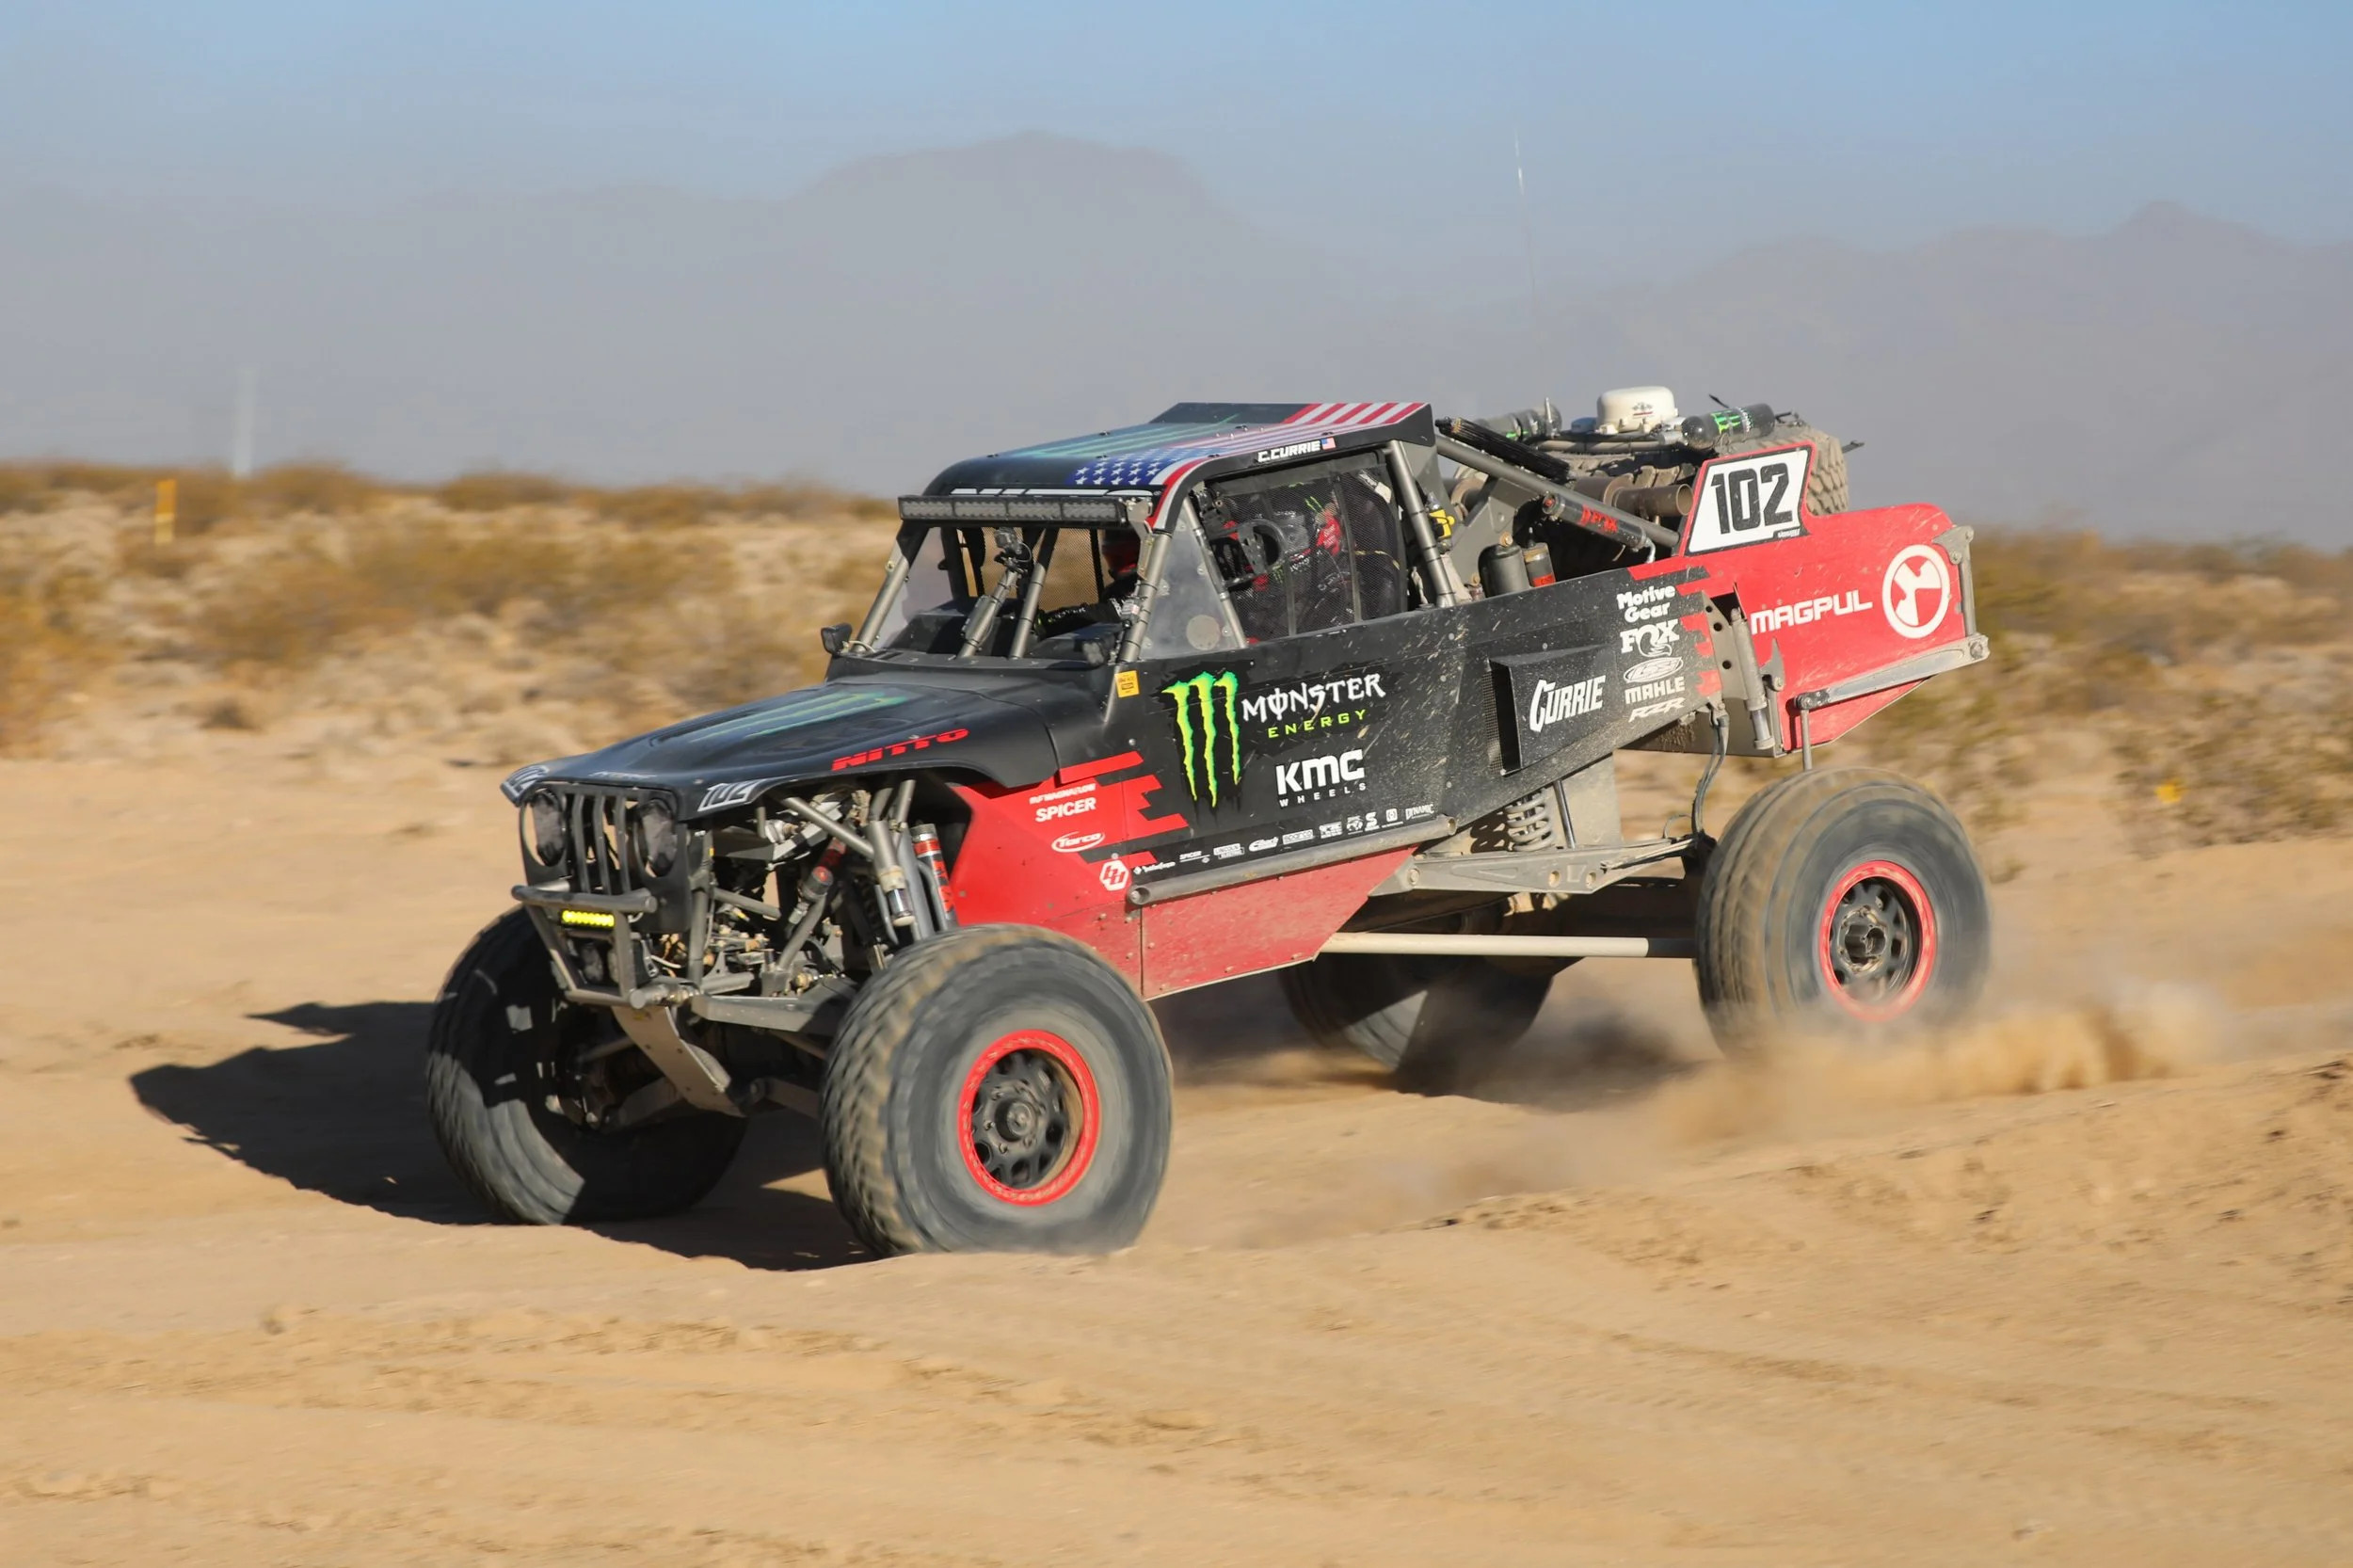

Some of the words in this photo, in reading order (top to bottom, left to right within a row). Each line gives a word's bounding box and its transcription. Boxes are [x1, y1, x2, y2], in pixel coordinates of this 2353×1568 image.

[1257, 440, 1321, 463] C.CURRIE
[1710, 462, 1793, 535] 102
[1616, 585, 1676, 610] Motive
[1625, 602, 1671, 623] Gear
[1750, 589, 1873, 635] MAGPUL
[1620, 618, 1680, 657] FOX
[1241, 673, 1386, 723] MONSTER
[1529, 675, 1606, 732] CURRIE
[1625, 677, 1686, 704] MAHLE
[1268, 709, 1367, 739] ENERGY
[831, 728, 969, 772] NITTO
[1275, 749, 1366, 795] KMC
[1035, 797, 1096, 823] SPICER
[1279, 782, 1366, 808] WHEELS
